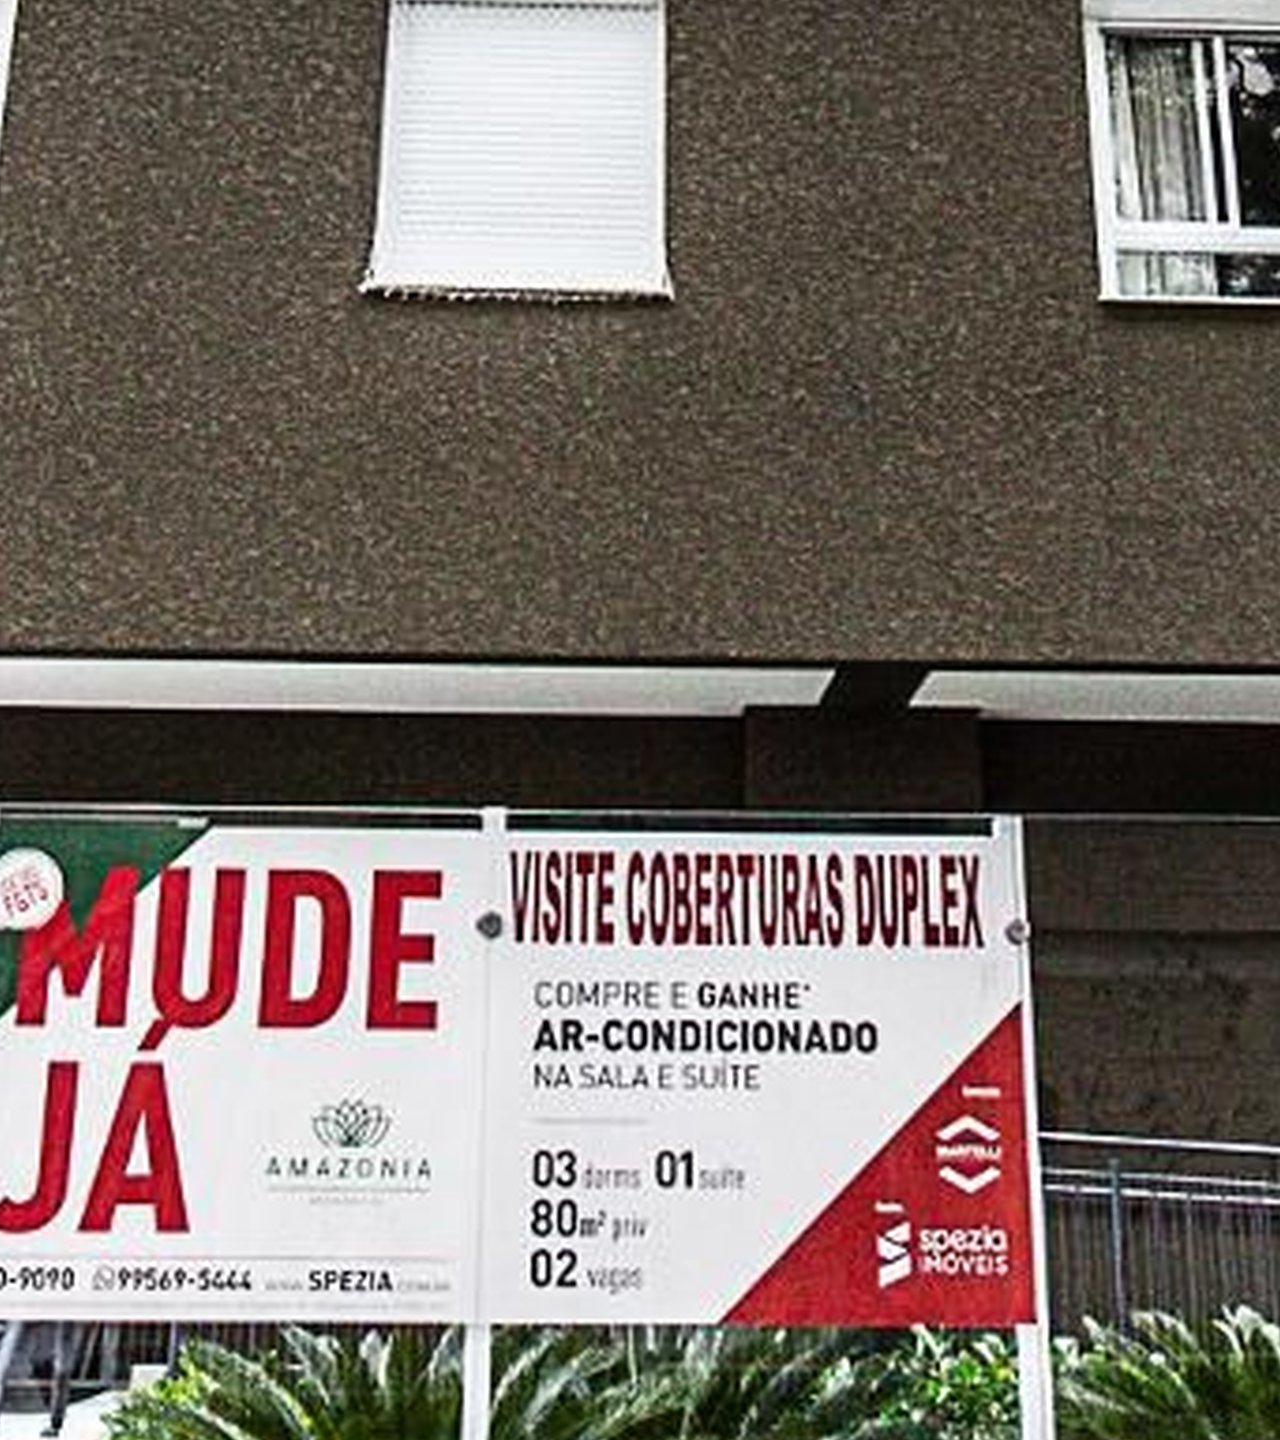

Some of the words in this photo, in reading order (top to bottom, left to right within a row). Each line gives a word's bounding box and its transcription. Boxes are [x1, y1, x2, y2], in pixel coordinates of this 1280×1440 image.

[511, 851, 616, 945] VISITE
[626, 851, 844, 948] COBERTURAS
[855, 854, 984, 949] DUPLEX
[15, 866, 442, 1029] MUDE
[534, 981, 660, 1009] COMPRE
[670, 982, 688, 1009] E
[534, 1020, 878, 1054] AR-CONDICIONADO
[534, 1063, 572, 1088] NA
[578, 1063, 649, 1089] SALA
[657, 1064, 671, 1089] E
[266, 1156, 432, 1180] AMAZONIA
[533, 1150, 577, 1188] 03
[655, 1150, 694, 1189] 01
[308, 1270, 393, 1291] SPEZIA
[531, 1248, 577, 1288] 02
